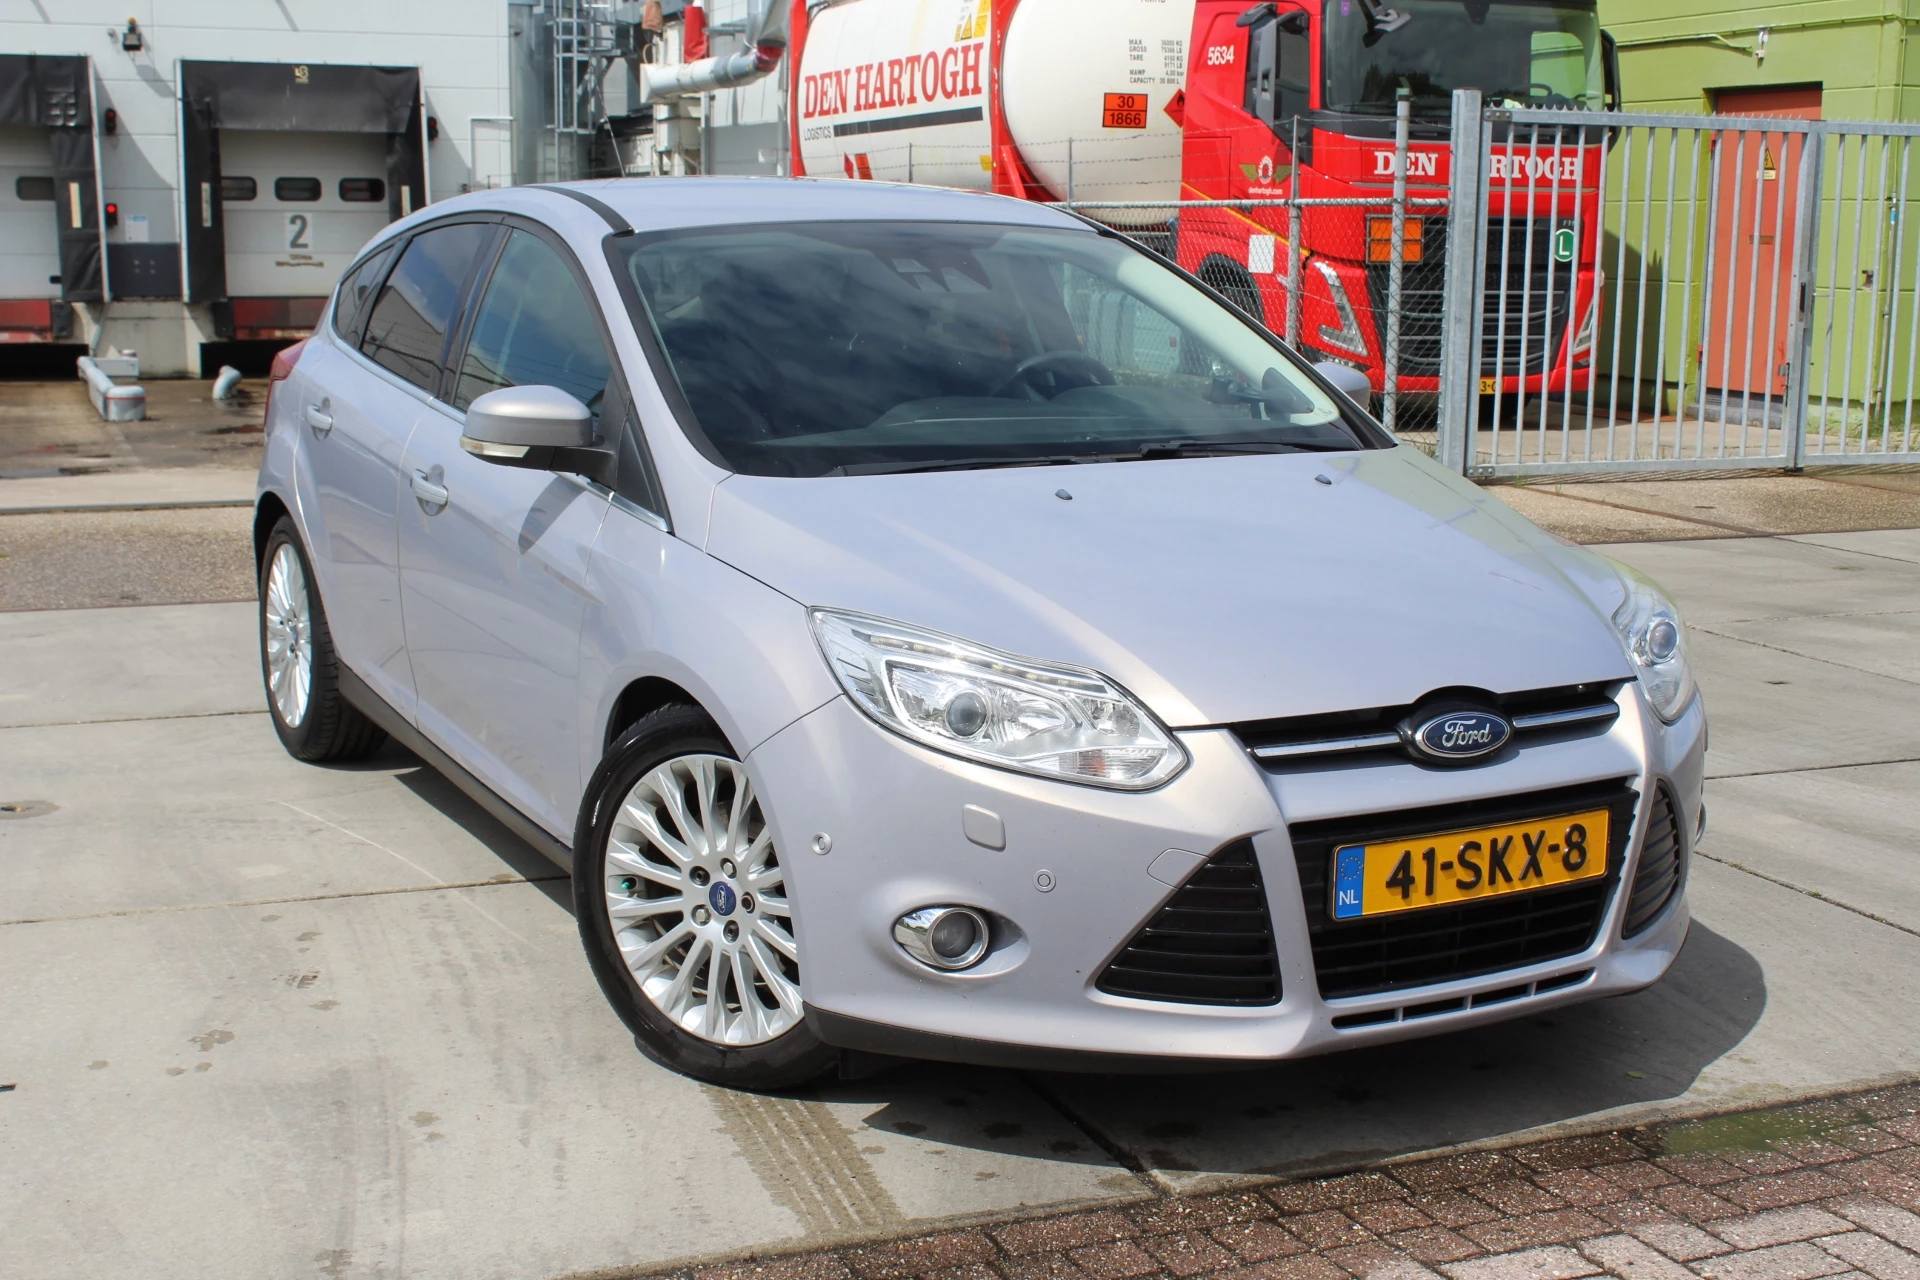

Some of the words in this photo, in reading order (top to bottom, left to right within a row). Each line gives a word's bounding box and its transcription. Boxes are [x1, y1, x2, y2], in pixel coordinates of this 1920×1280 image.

[1207, 45, 1235, 66] 5634
[803, 68, 851, 119] DEN
[853, 42, 984, 112] HARTOGH
[1117, 95, 1135, 109] 30
[1109, 112, 1142, 126] 1866
[803, 125, 832, 141] LOGISTICS
[289, 214, 309, 249] 2
[1558, 235, 1570, 256] L
[1441, 718, 1492, 747] Ford
[1385, 822, 1588, 900] 41-SKX-8
[1338, 889, 1360, 906] NL
